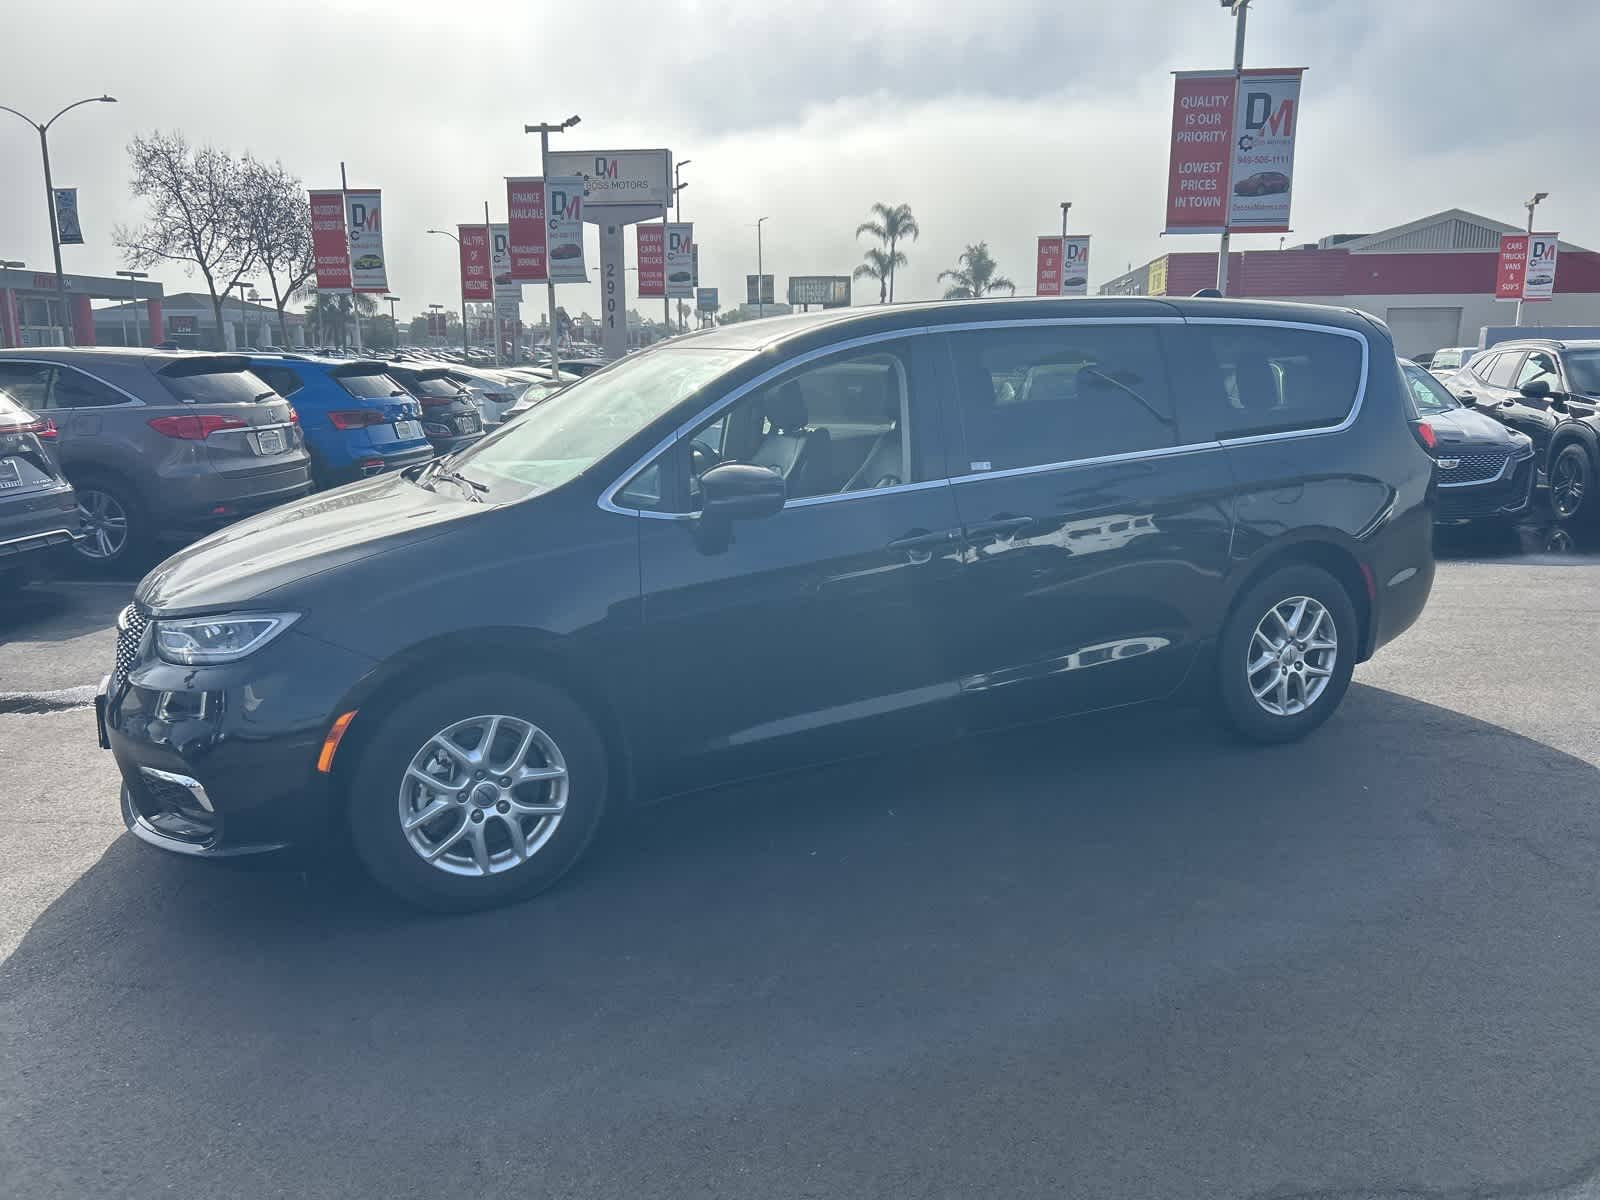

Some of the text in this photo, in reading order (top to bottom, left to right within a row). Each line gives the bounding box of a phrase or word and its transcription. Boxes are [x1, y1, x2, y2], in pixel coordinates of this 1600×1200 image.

[1181, 96, 1229, 109] QUALITY
[1185, 113, 1221, 125] IS OUR
[1176, 130, 1227, 143] PRIORITY
[1178, 162, 1223, 174] LOWEST
[611, 181, 649, 190] MOTORS
[1181, 179, 1217, 191] PRICES
[512, 192, 540, 202] FINANCE
[1175, 197, 1187, 208] IN
[1189, 196, 1221, 208] TOWN
[510, 209, 544, 219] AVAILABLE
[1507, 242, 1523, 250] CARS
[640, 256, 663, 265] TRUCKS
[1505, 262, 1521, 270] VANS
[606, 263, 616, 329] 2901
